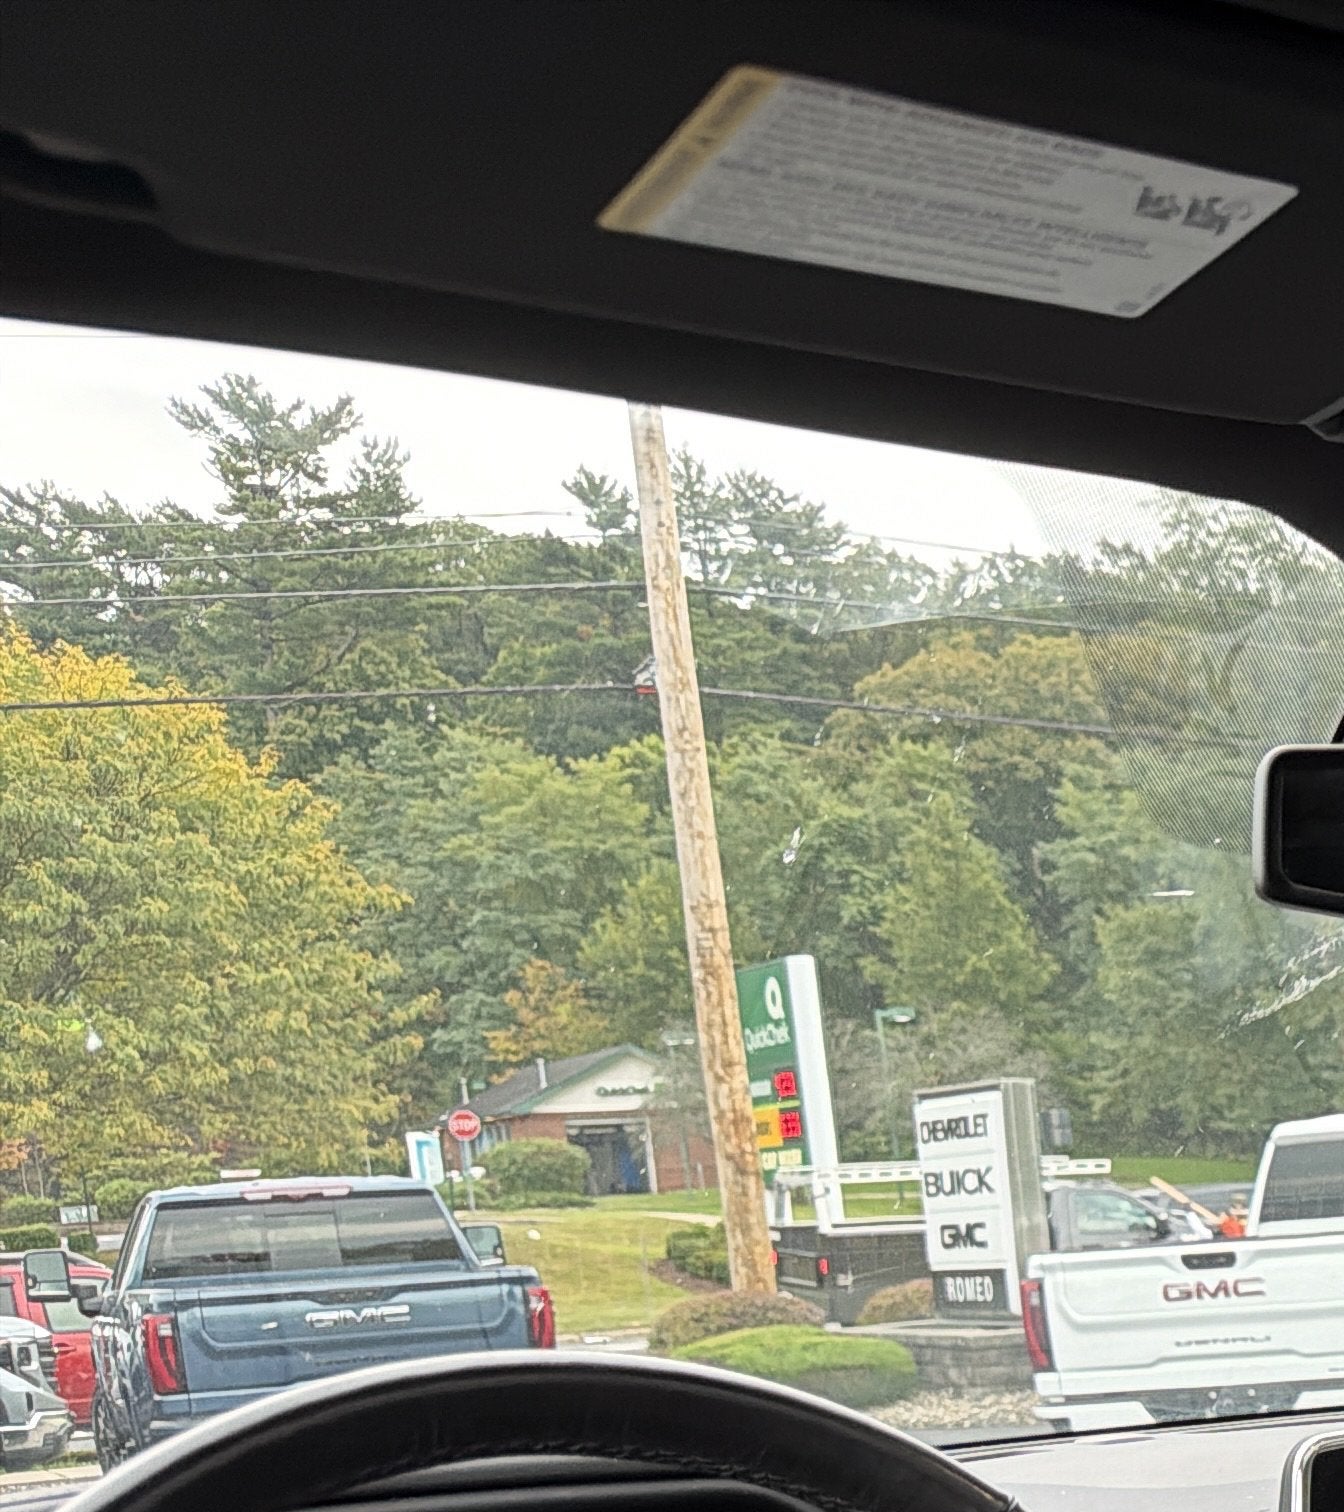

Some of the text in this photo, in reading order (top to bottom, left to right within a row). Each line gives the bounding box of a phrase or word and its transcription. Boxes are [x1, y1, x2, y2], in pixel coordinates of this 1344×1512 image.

[765, 976, 785, 1020] Q
[449, 1119, 479, 1133] STOP
[920, 1113, 989, 1144] CHEVROLET
[924, 1165, 996, 1198] BUICK
[940, 1221, 988, 1249] GMC
[944, 1275, 994, 1303] ROMEO
[1162, 1277, 1266, 1302] GMC
[304, 1303, 411, 1330] GMC
